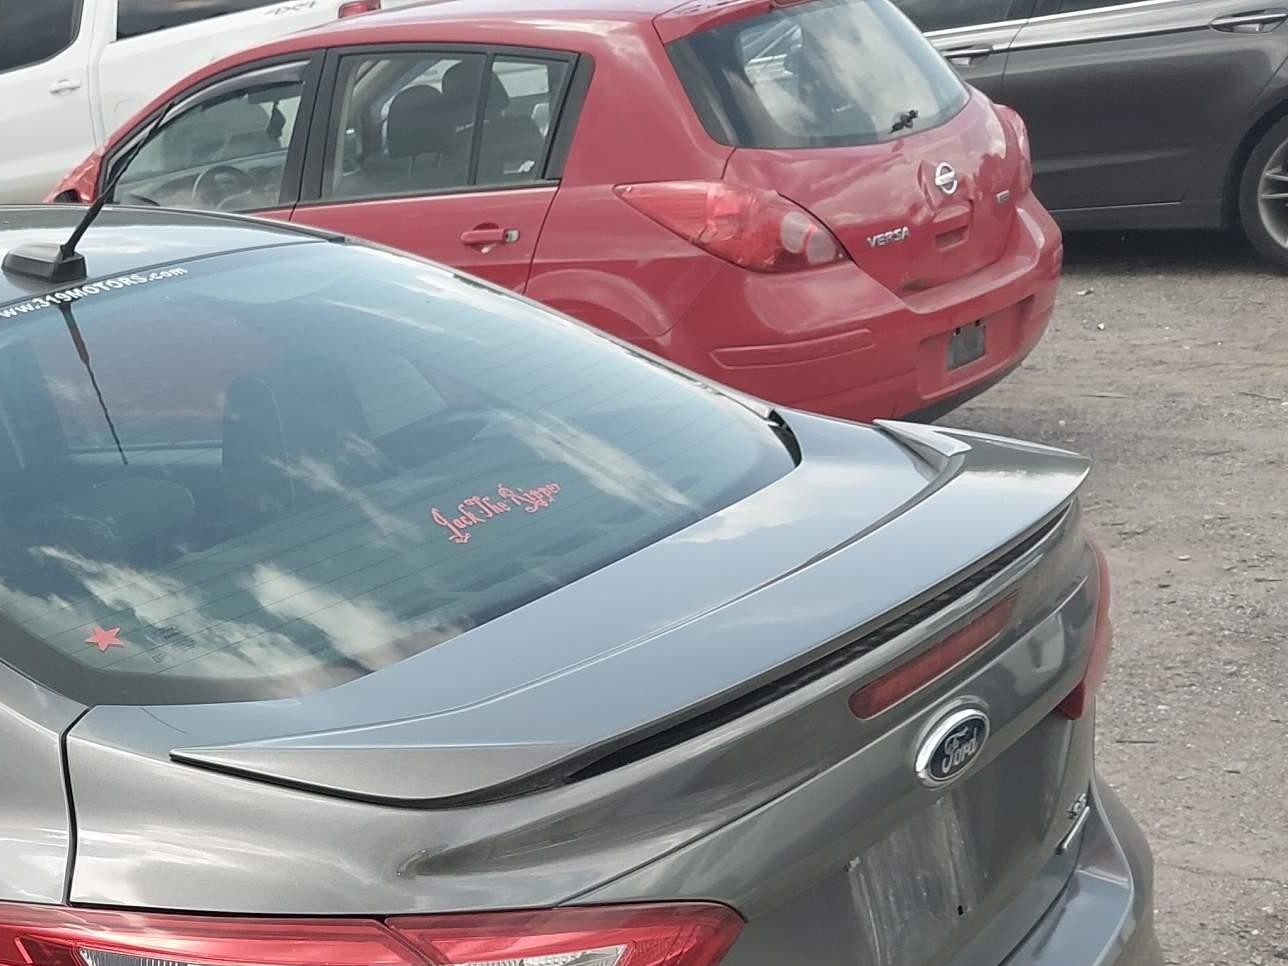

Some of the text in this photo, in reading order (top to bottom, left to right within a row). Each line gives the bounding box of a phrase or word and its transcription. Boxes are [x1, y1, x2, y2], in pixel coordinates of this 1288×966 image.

[866, 226, 910, 248] VERSA
[431, 503, 486, 544] Jack
[463, 496, 511, 518] The
[941, 725, 980, 775] Ford
